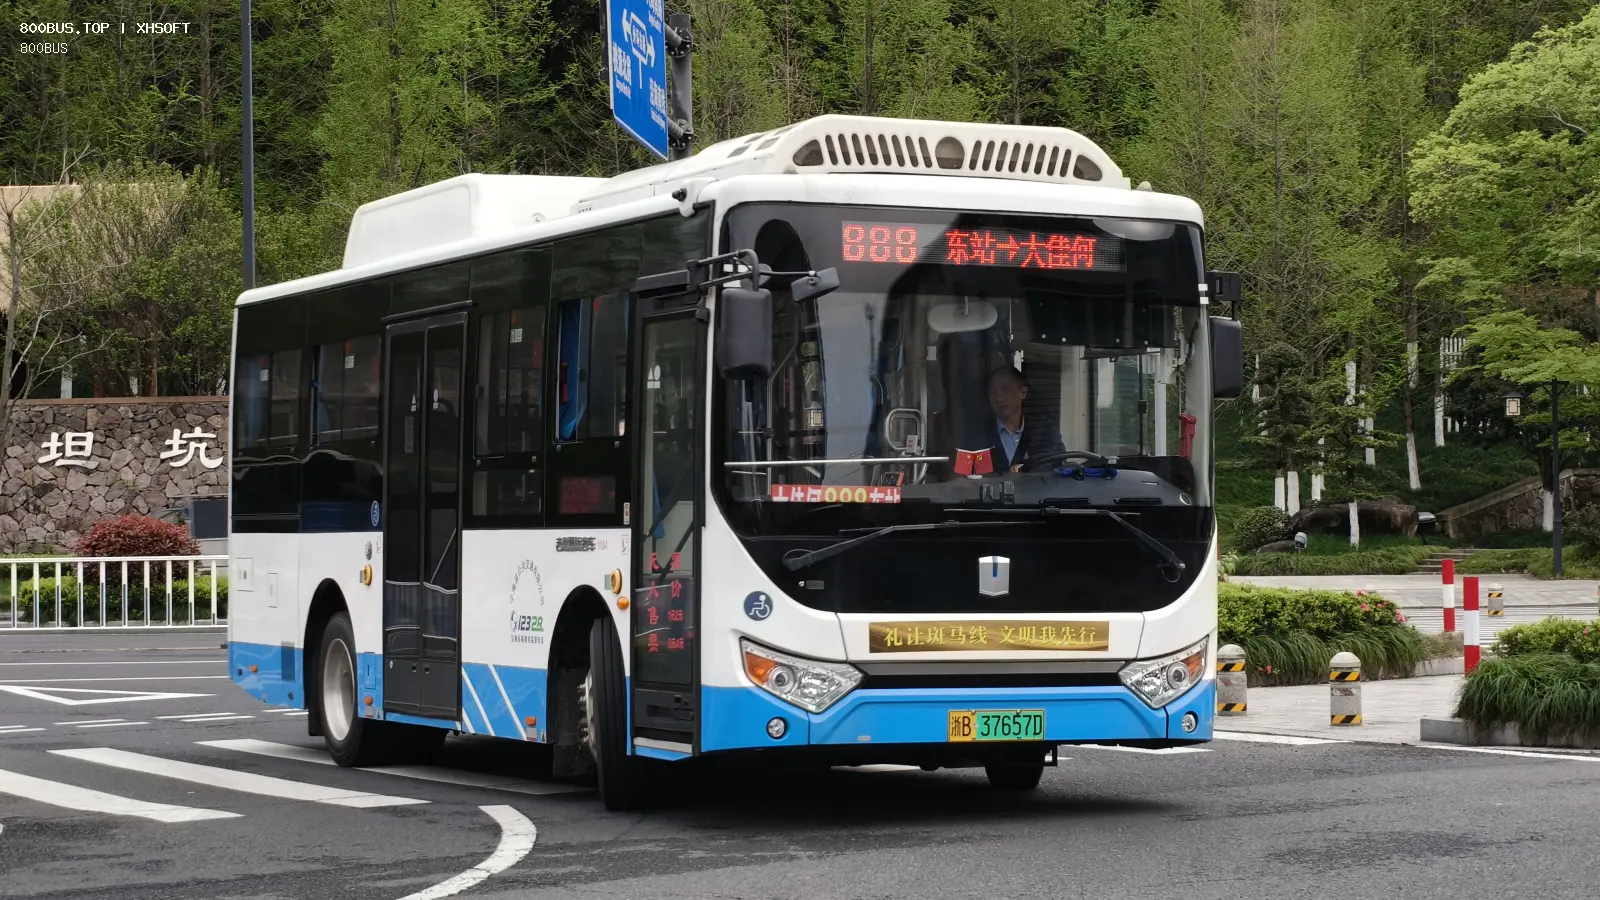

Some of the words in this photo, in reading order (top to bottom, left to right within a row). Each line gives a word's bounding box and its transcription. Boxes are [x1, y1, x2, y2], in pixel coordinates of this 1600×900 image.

[843, 224, 916, 262] 888
[884, 625, 988, 647] 礼让斑马线
[998, 625, 1096, 645] 文明我先行
[980, 714, 1043, 737] 37657D
